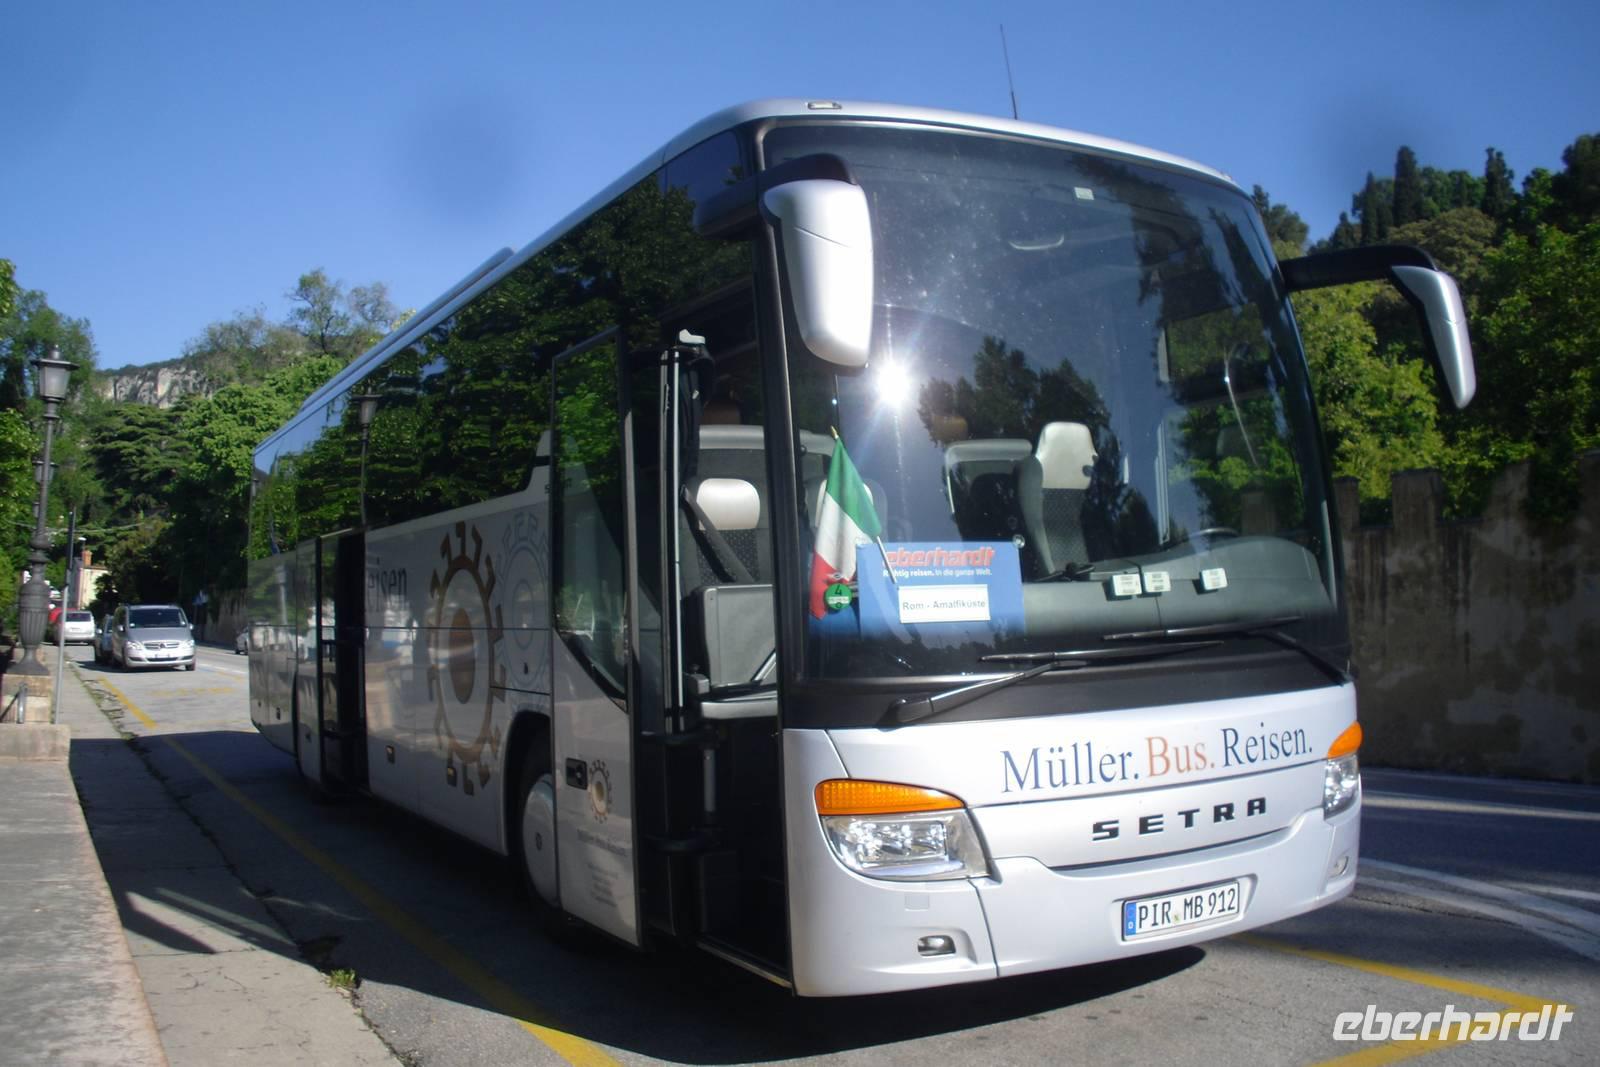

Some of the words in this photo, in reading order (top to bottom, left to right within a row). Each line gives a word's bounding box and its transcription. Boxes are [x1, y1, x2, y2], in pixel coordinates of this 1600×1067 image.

[367, 556, 408, 611] eisen
[834, 584, 843, 596] 4
[902, 601, 924, 610] Rom
[932, 599, 986, 609] Amalfiküste
[1001, 742, 1139, 794] Müller.
[1145, 736, 1215, 777] Bus.
[1221, 722, 1313, 767] Reisen.
[1092, 797, 1267, 842] SETRA
[1138, 901, 1171, 929] PIR
[1184, 895, 1204, 921] MB
[1208, 888, 1236, 916] 912
